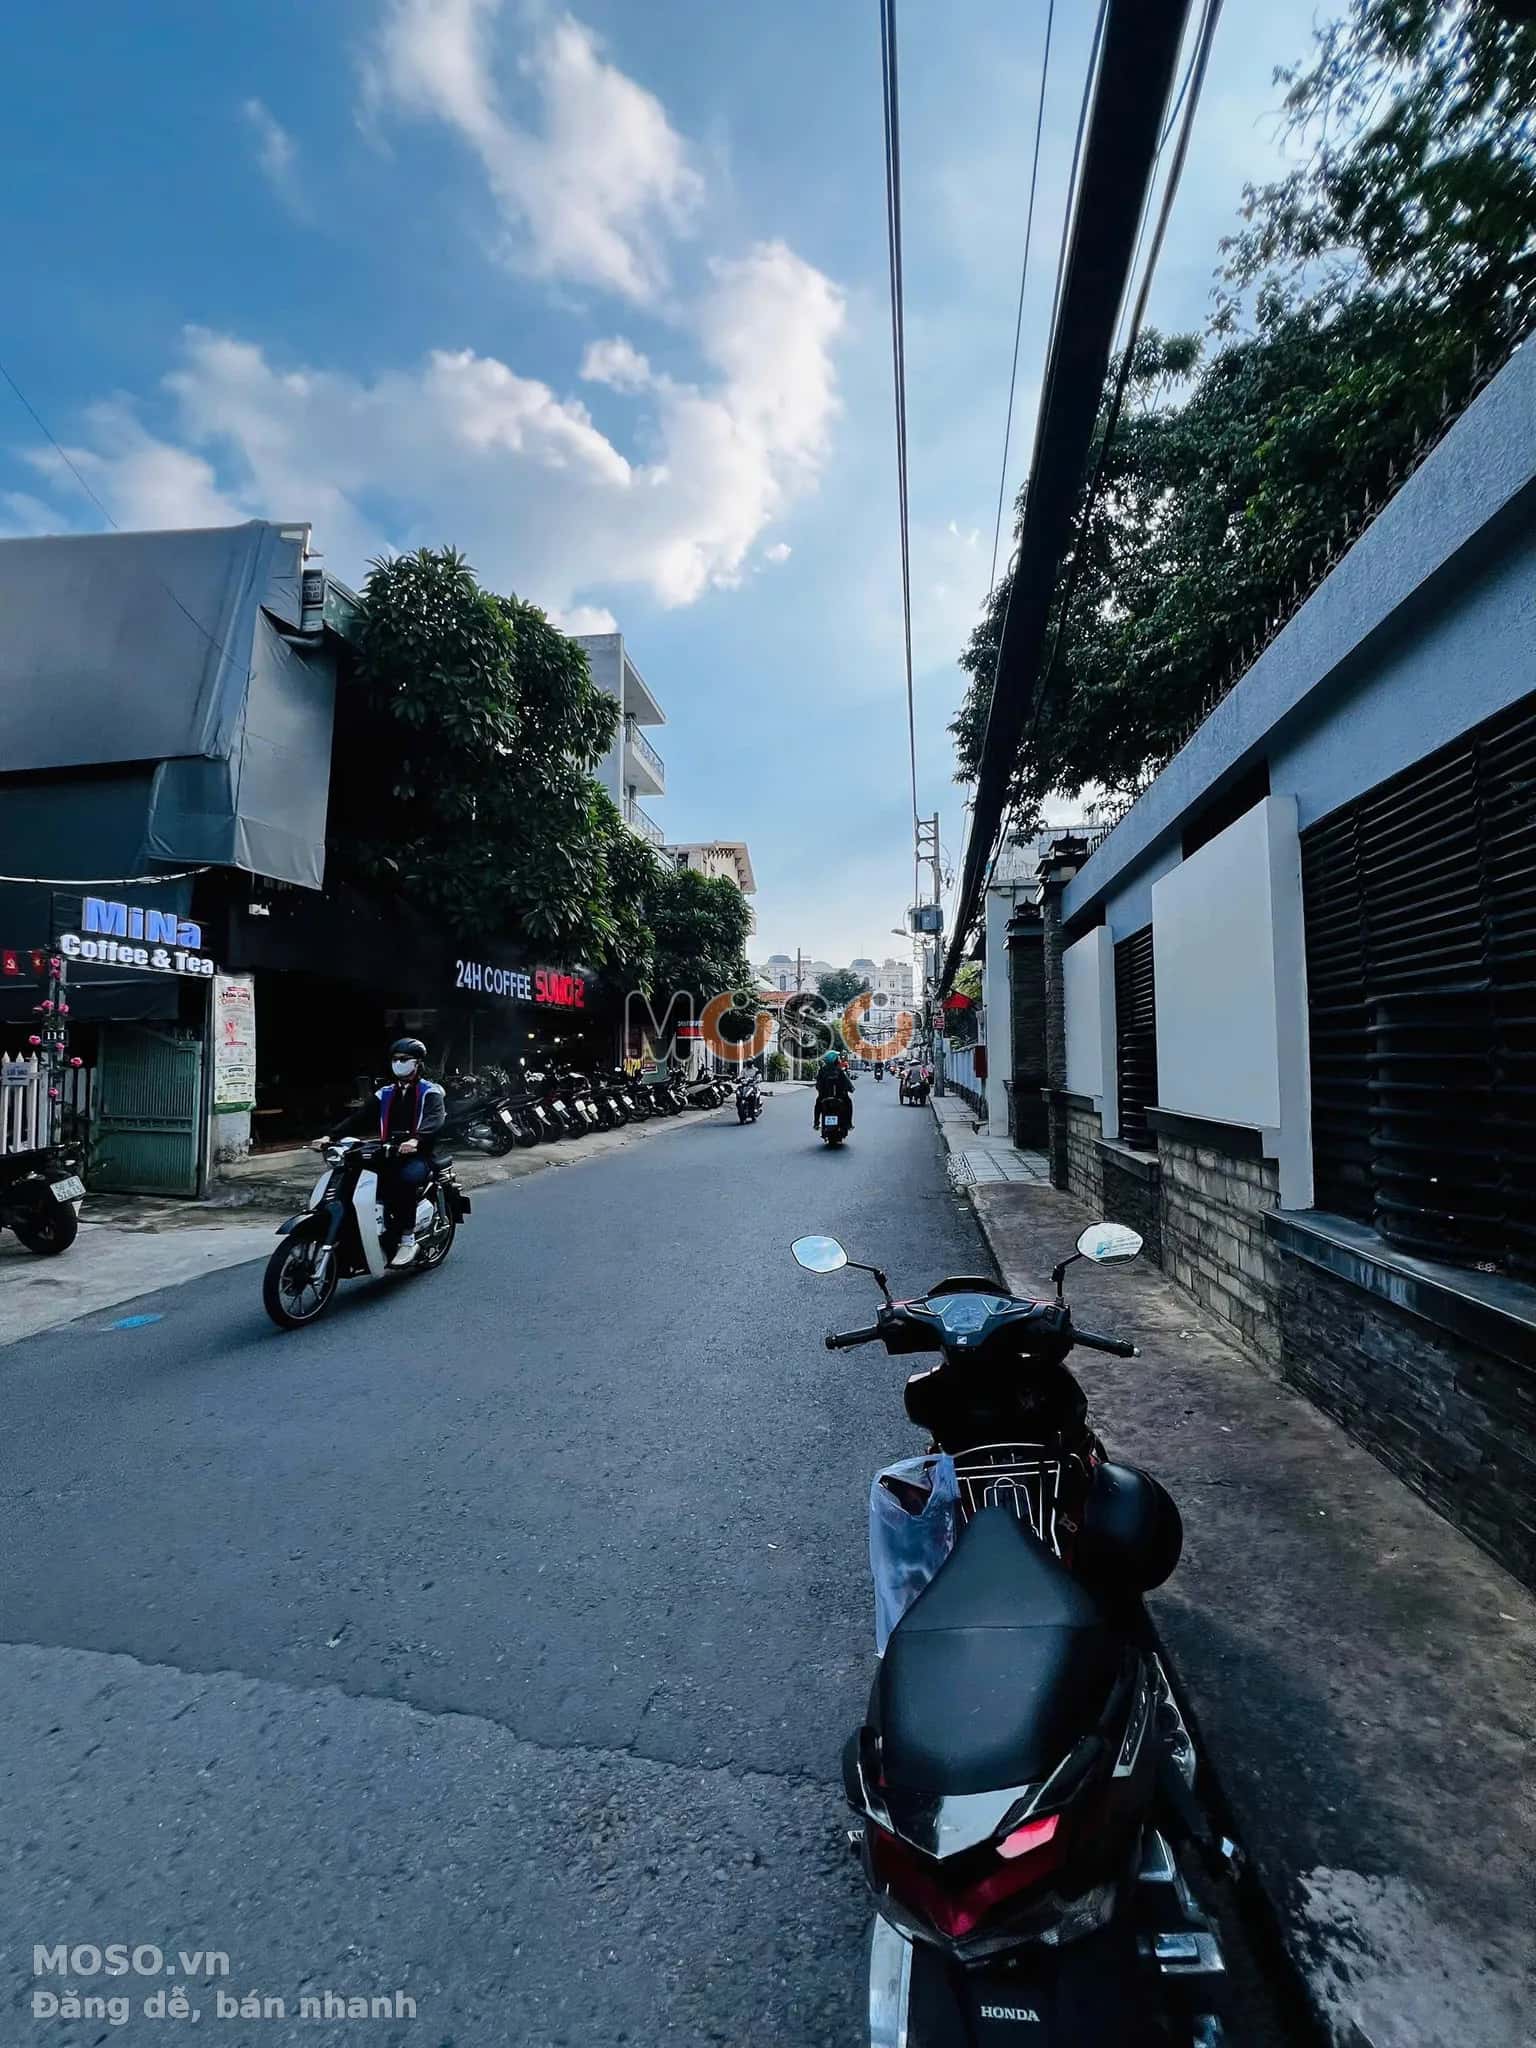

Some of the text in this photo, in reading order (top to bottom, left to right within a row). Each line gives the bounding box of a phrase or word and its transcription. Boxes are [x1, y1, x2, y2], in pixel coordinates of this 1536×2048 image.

[81, 896, 202, 949] MiNa
[60, 934, 214, 975] Coffee & Tea
[456, 959, 481, 991] 24H
[484, 966, 533, 1001] COFFEE
[981, 2005, 1041, 2022] HONDA
